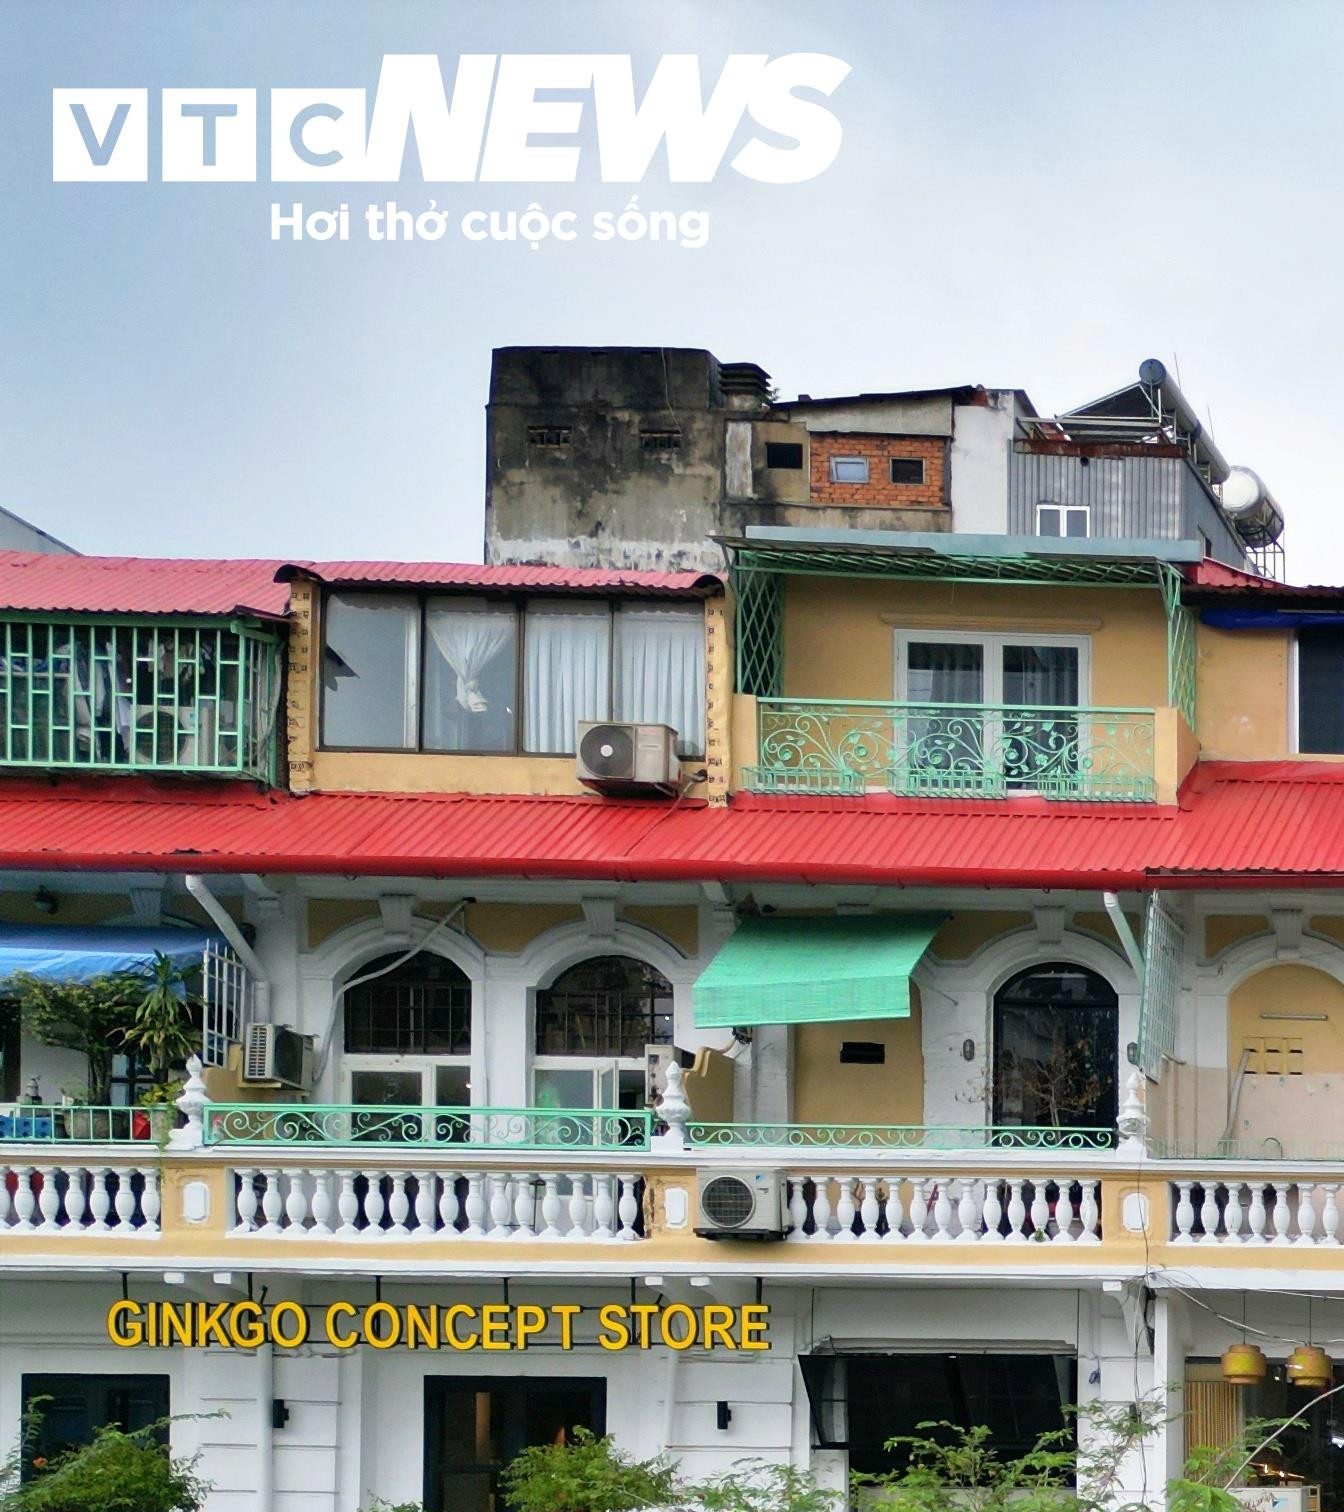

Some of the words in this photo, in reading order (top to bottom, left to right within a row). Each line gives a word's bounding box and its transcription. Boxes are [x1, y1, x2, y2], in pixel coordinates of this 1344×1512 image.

[107, 1300, 307, 1348] GINKGO
[325, 1301, 581, 1351] CONCEPT
[598, 1304, 772, 1351] STORE
